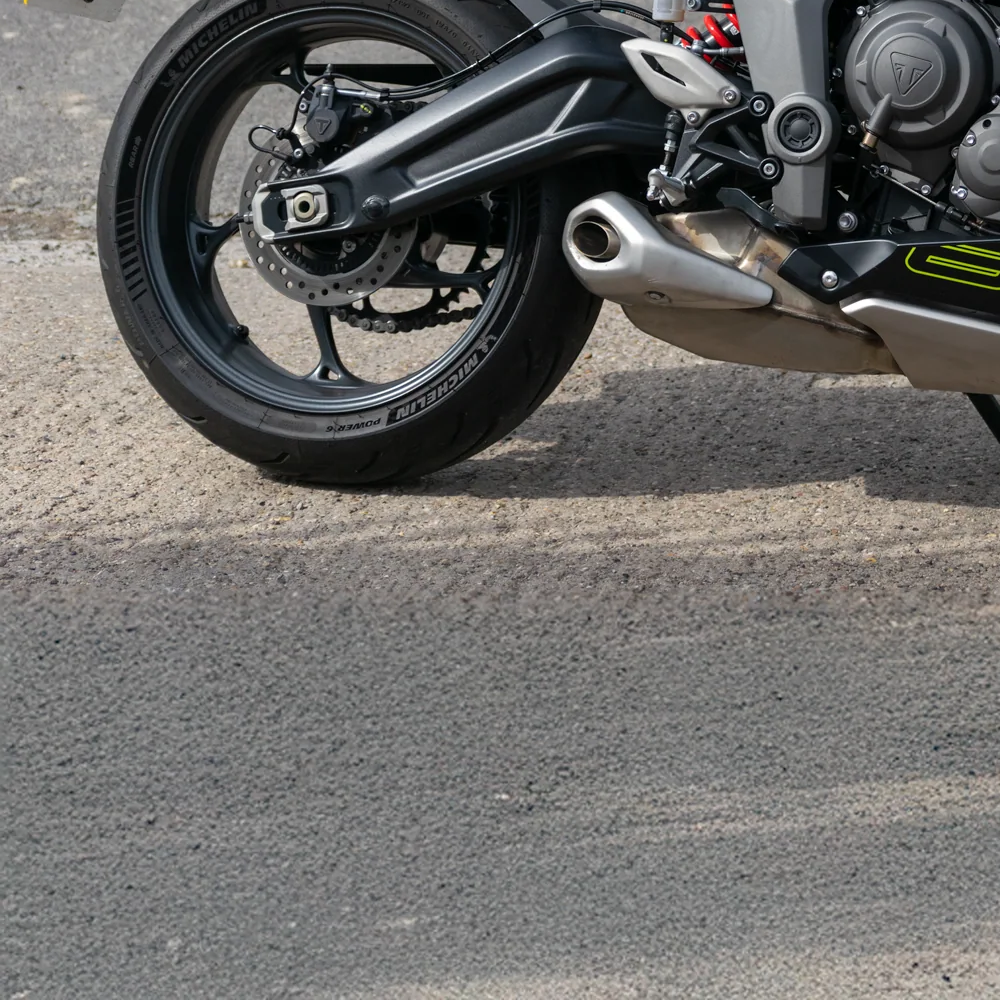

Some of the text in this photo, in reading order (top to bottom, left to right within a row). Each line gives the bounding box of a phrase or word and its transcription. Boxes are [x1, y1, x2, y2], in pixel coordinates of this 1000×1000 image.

[176, 0, 260, 70] MICHELIN
[128, 145, 139, 169] REAR
[396, 352, 478, 420] MICHELIN
[324, 417, 382, 433] POWER 6
